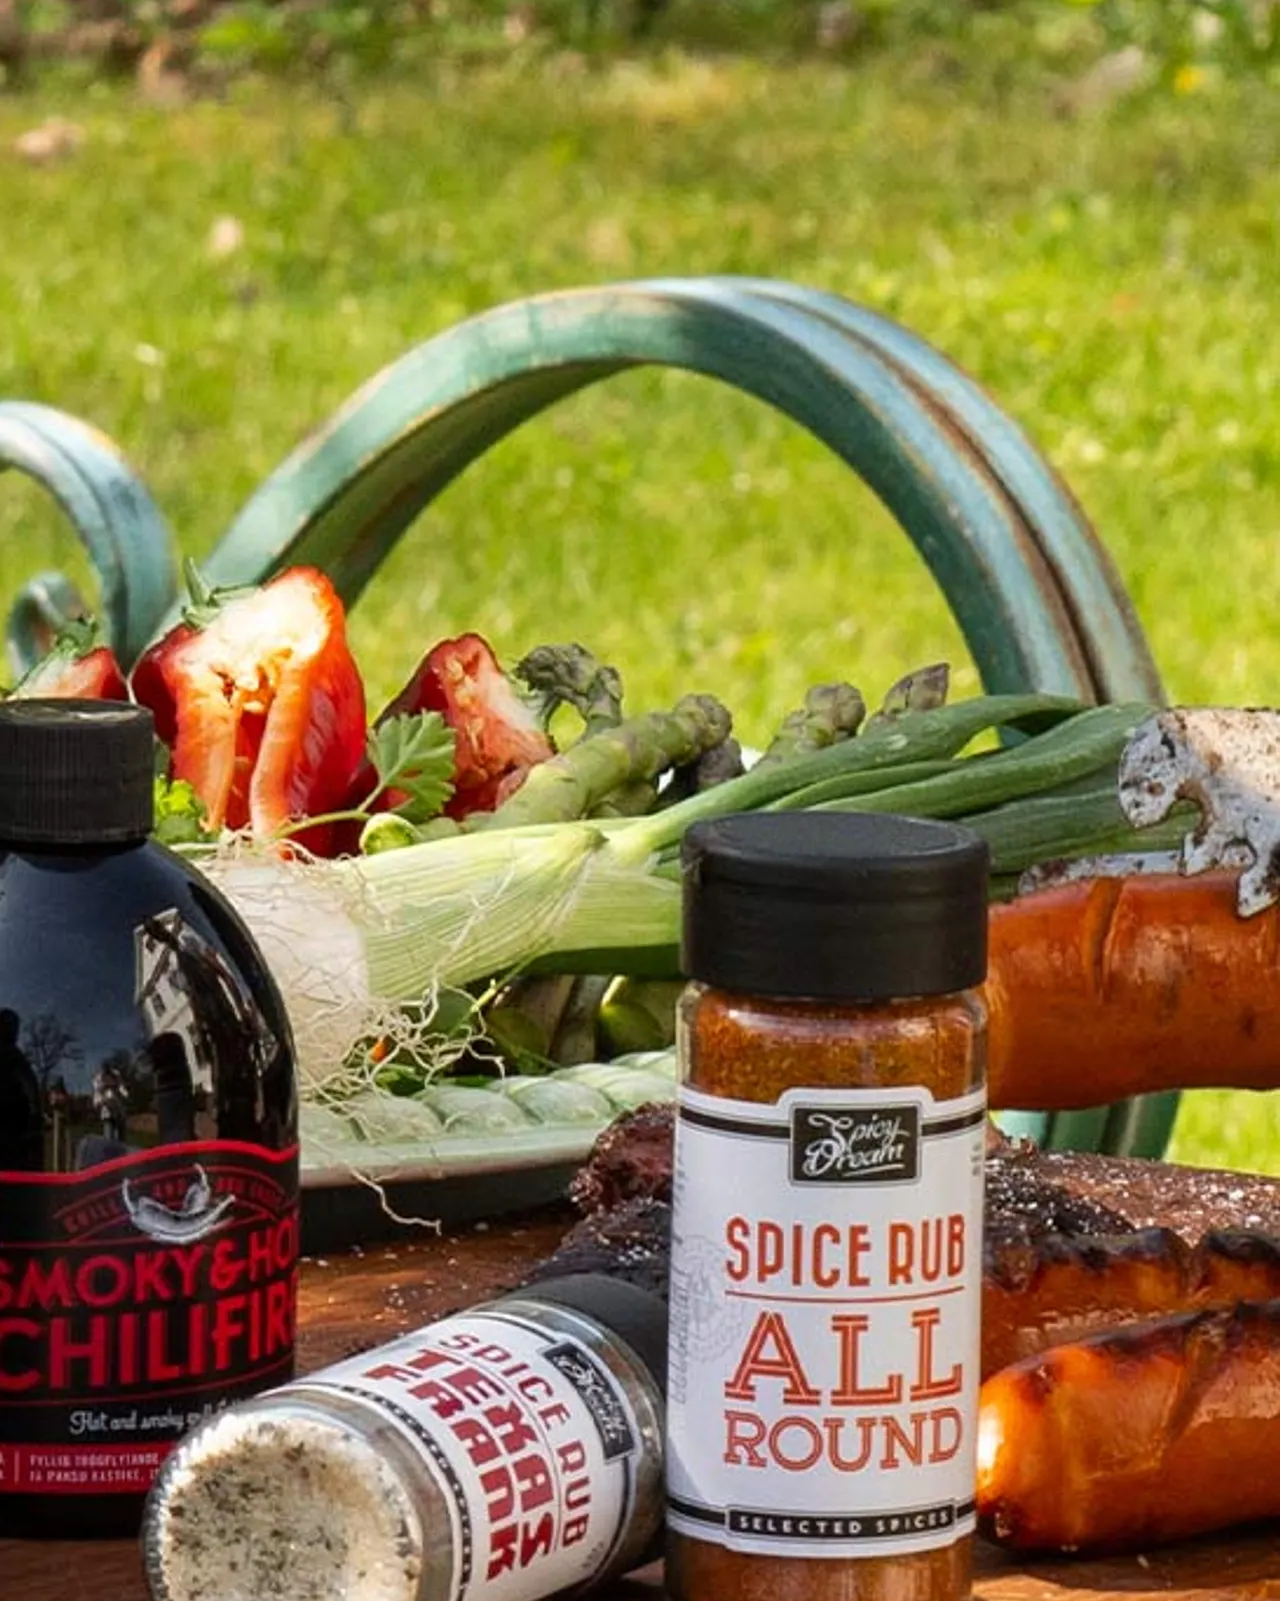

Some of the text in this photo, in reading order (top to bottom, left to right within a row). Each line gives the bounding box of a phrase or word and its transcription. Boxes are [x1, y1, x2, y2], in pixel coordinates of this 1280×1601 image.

[803, 1139, 904, 1178] Dream
[806, 1112, 910, 1157] Spicy
[209, 1240, 246, 1291] &
[249, 1210, 300, 1282] HO
[725, 1214, 965, 1288] SPICE RUB
[724, 1308, 963, 1407] ALL
[69, 1409, 108, 1436] Hot
[110, 1410, 137, 1431] and
[408, 1348, 556, 1570] TEXAS
[439, 1333, 592, 1549] SPICE RUB
[723, 1407, 963, 1473] ROUND
[361, 1363, 517, 1582] FRANK
[740, 1511, 950, 1536] SELECTED SPICES
